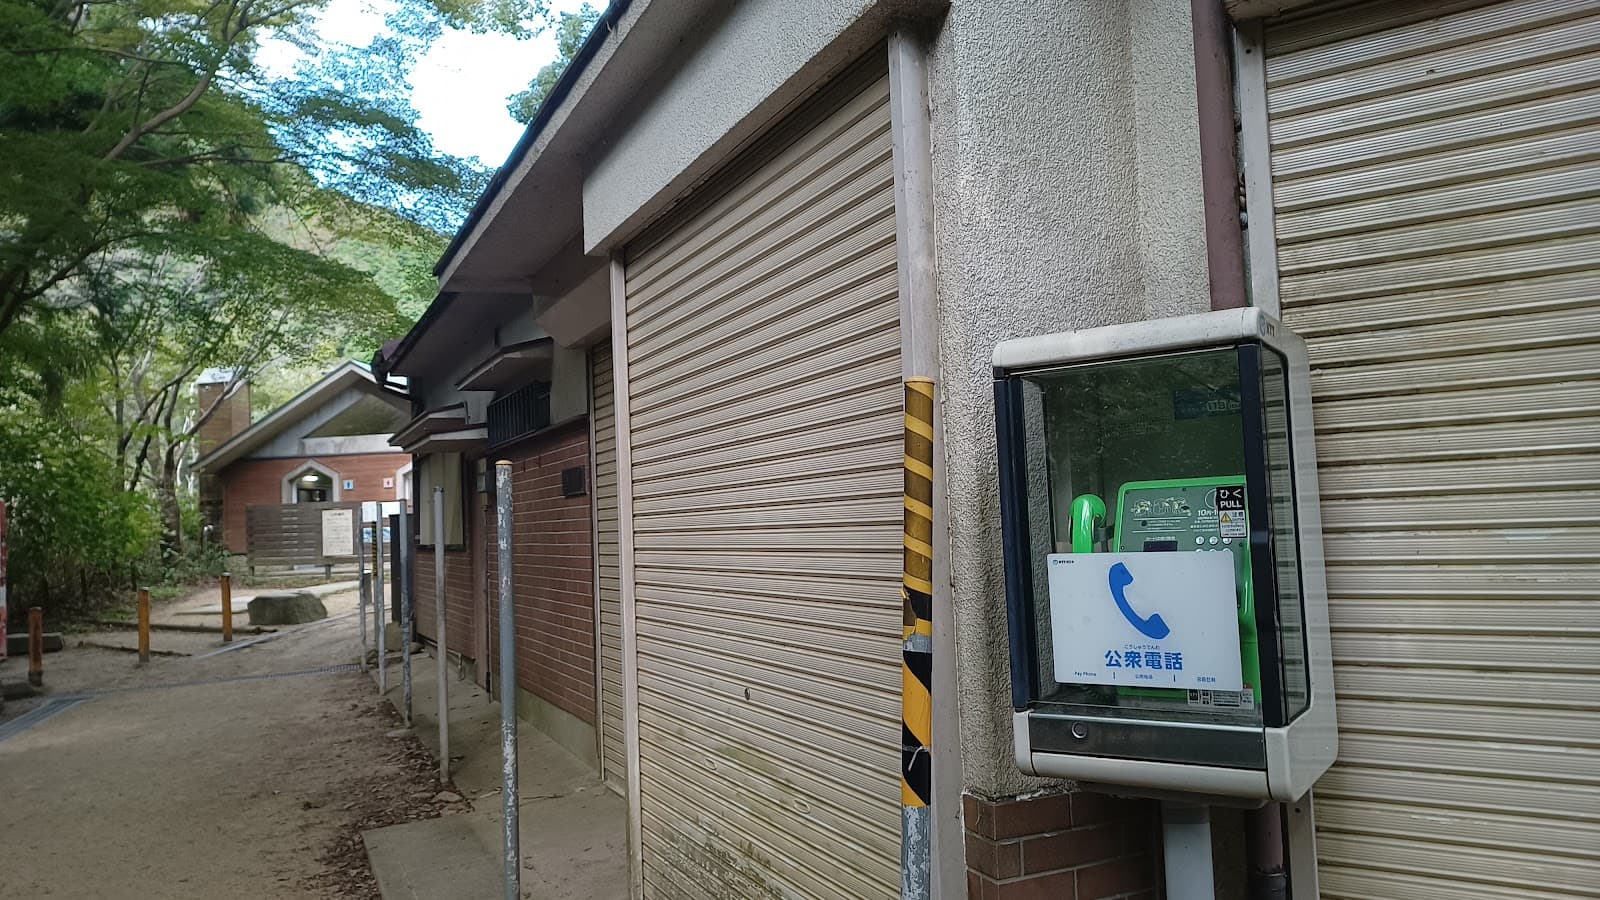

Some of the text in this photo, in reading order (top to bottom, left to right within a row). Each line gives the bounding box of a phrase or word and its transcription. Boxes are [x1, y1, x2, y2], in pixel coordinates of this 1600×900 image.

[1220, 489, 1242, 499] ひく
[1105, 650, 1183, 671] 公衆電話
